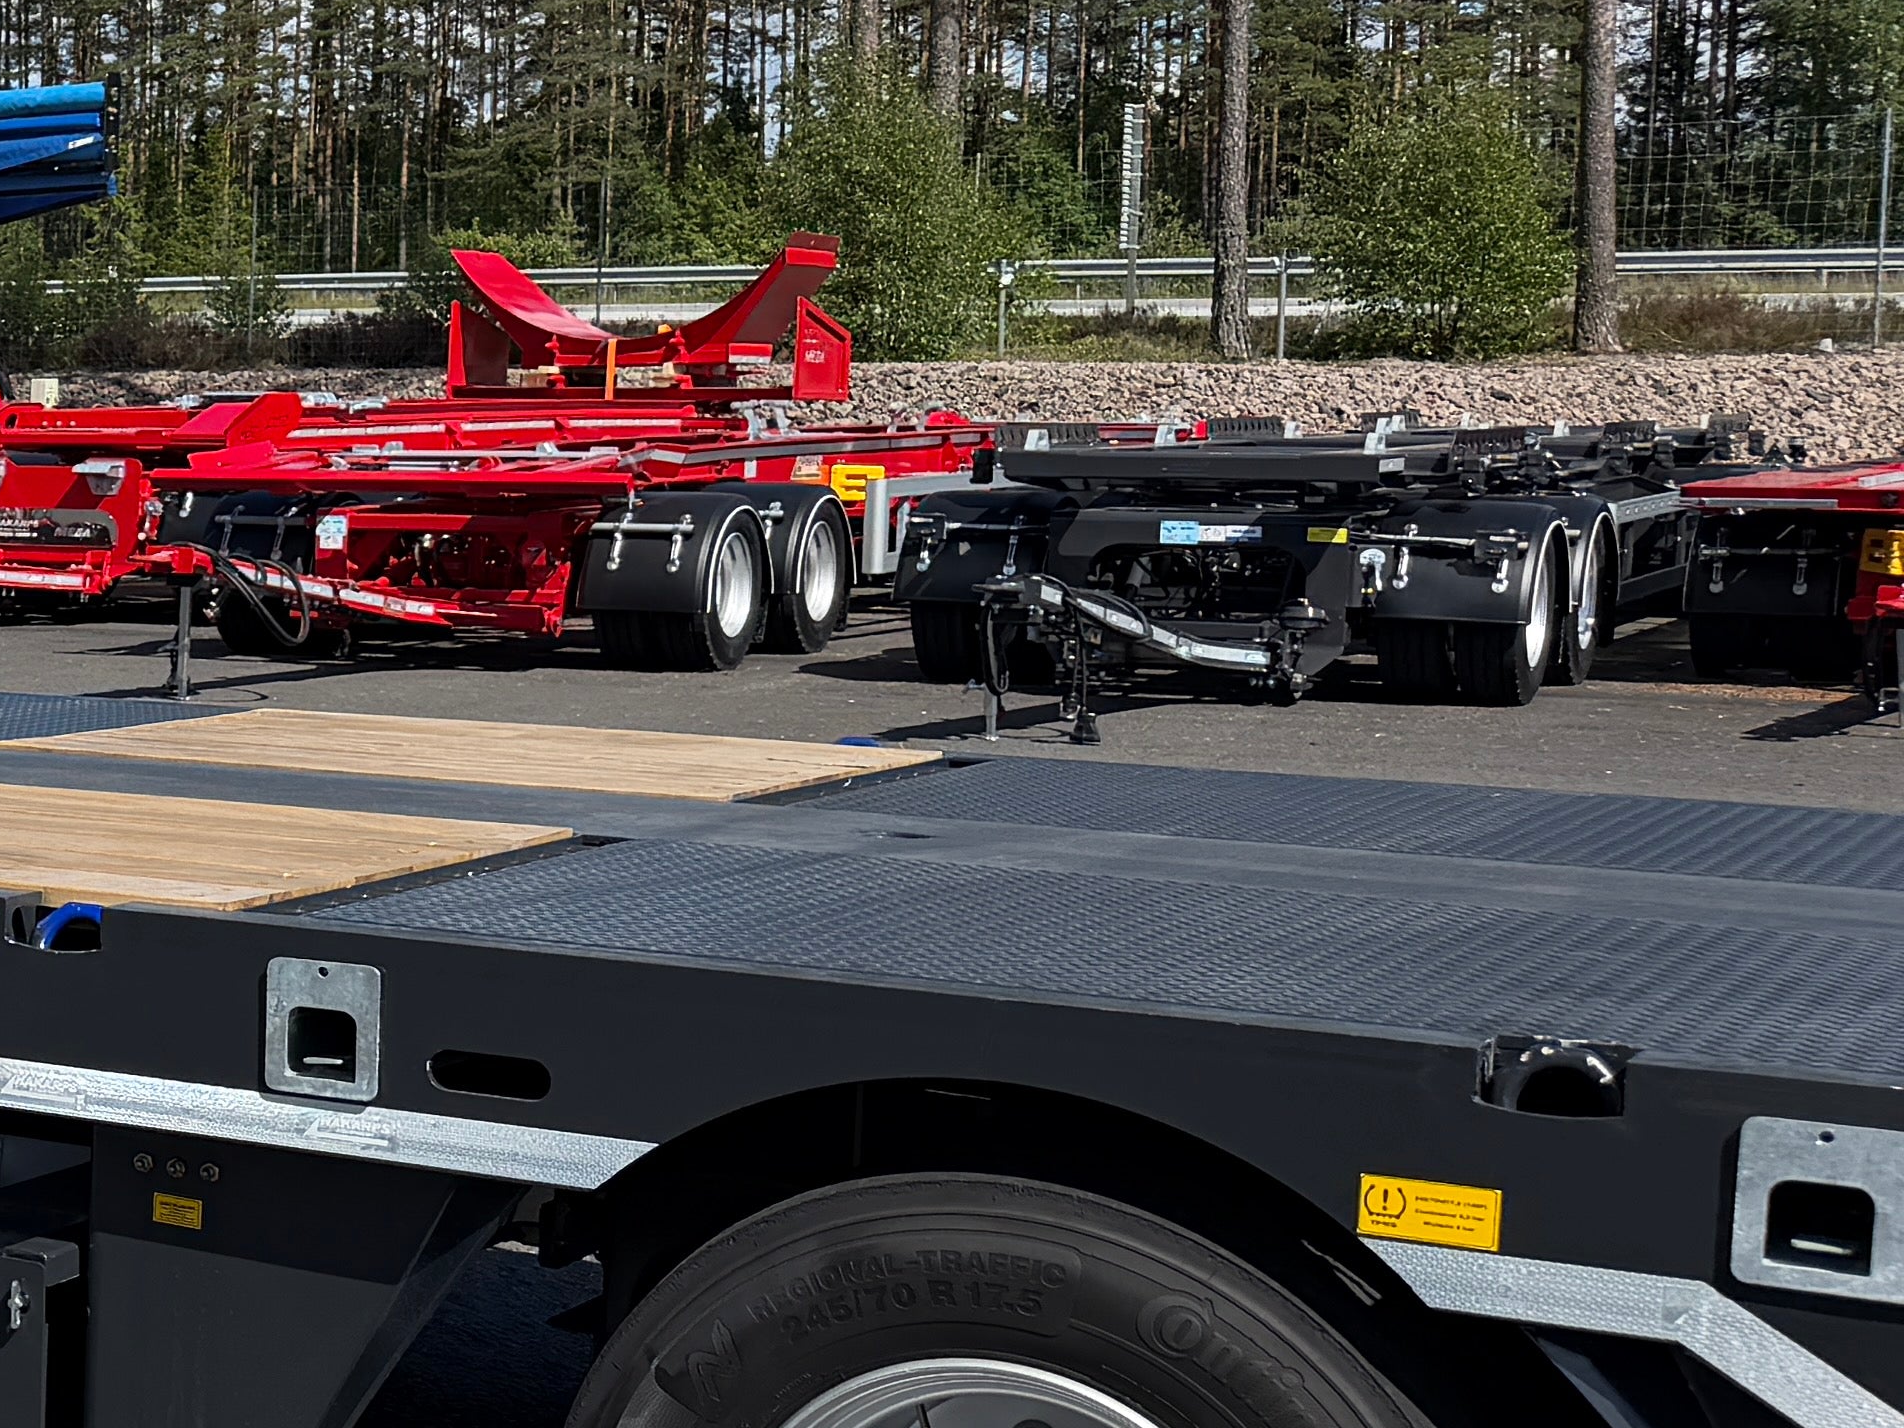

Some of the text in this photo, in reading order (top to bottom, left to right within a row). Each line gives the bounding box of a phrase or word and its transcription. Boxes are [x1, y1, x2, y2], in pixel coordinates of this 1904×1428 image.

[14, 1074, 79, 1093] HAKARPS
[744, 1247, 1068, 1325] REGIONAL-TRAFFIC
[779, 1278, 1046, 1345] 245/70 R 17.5
